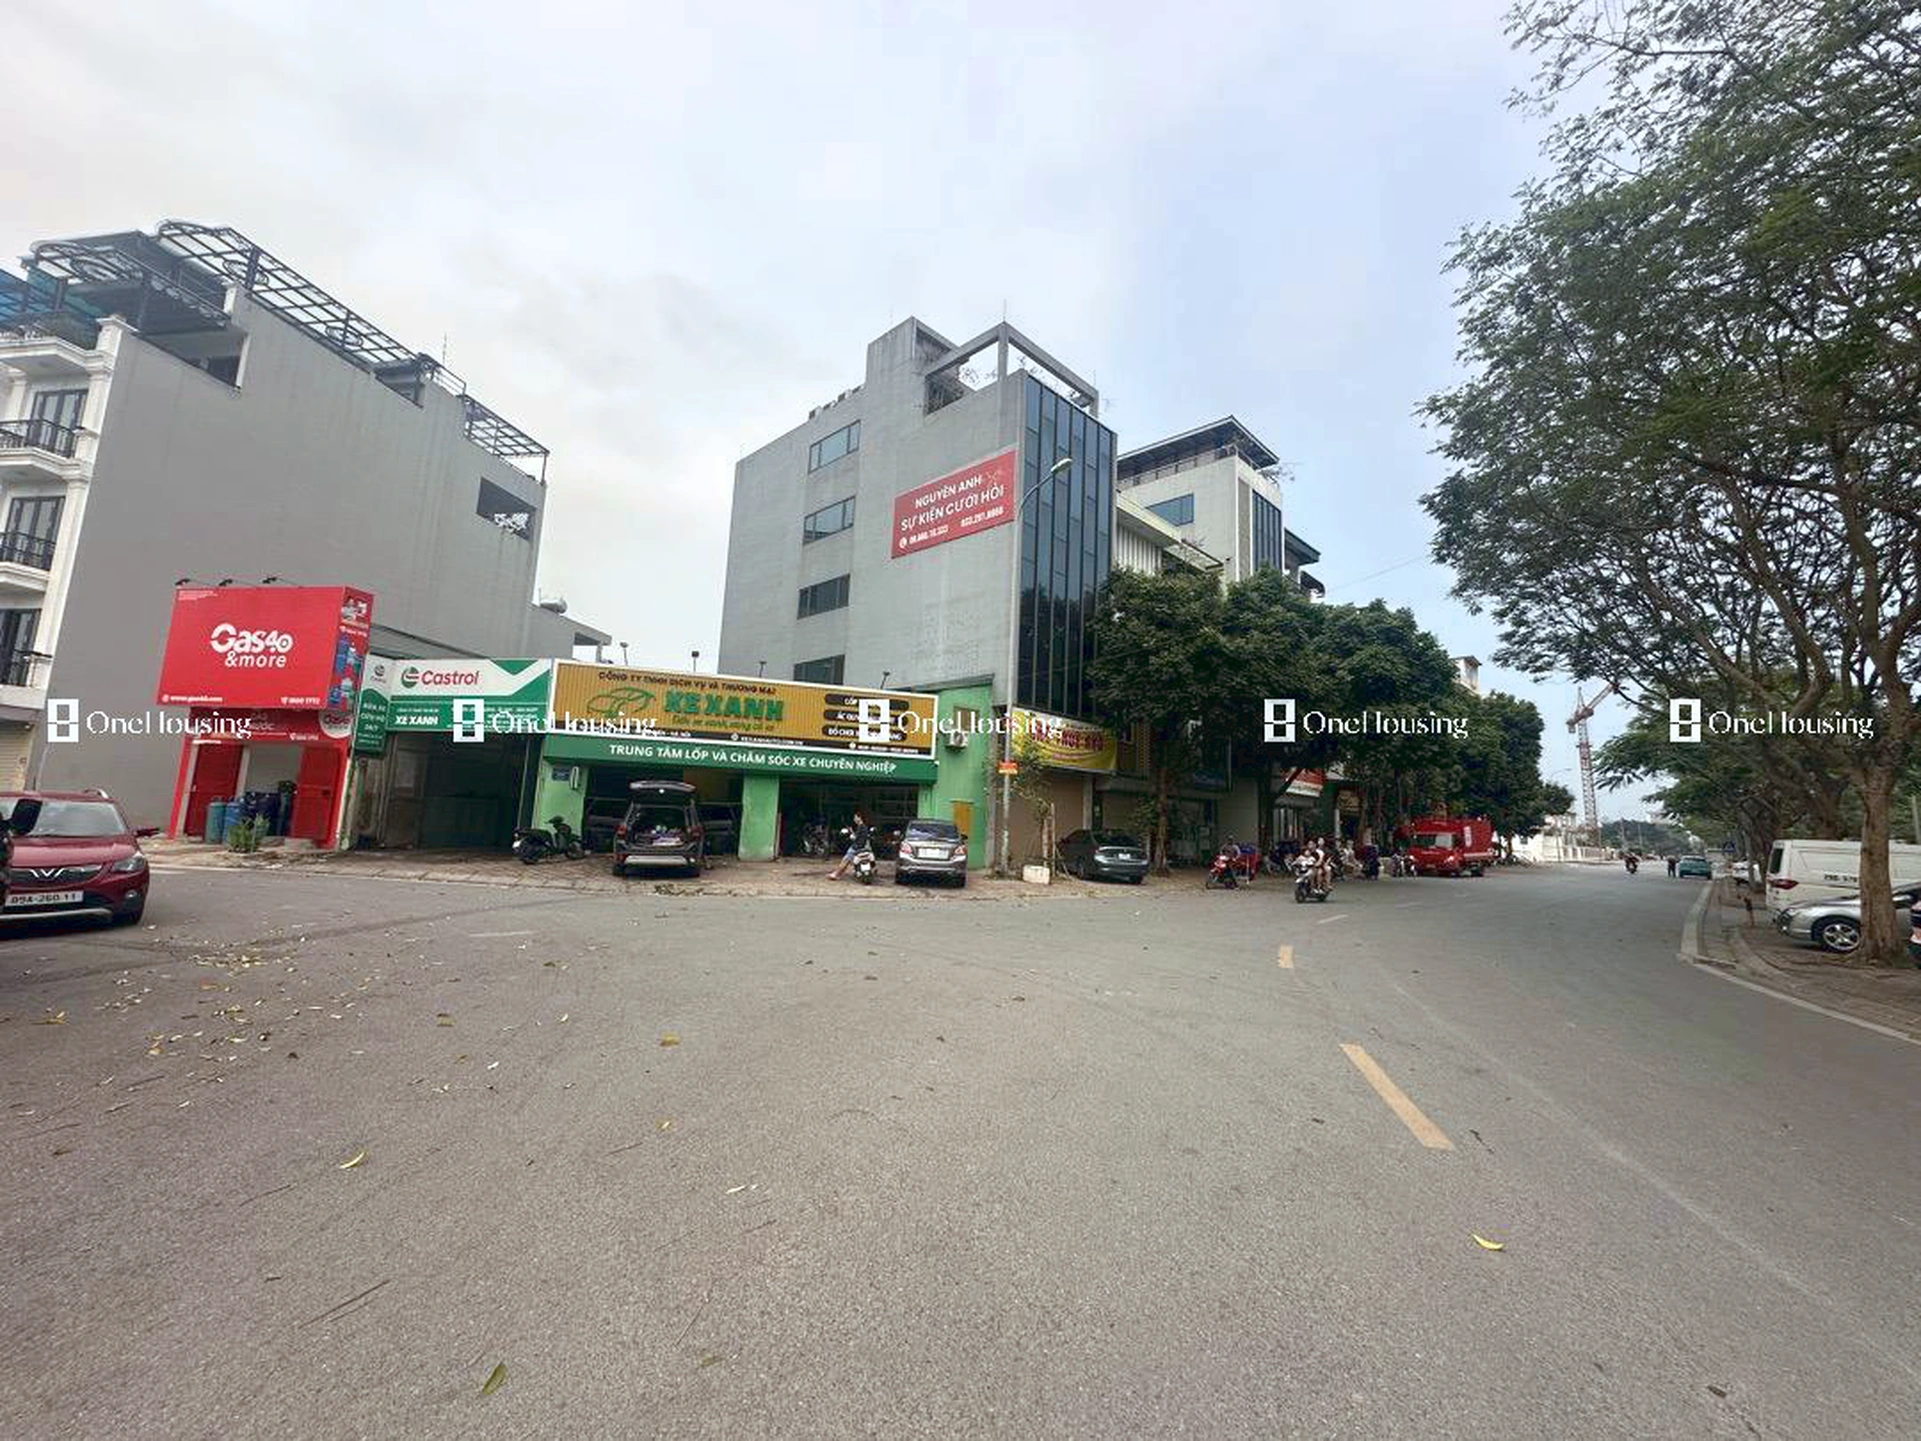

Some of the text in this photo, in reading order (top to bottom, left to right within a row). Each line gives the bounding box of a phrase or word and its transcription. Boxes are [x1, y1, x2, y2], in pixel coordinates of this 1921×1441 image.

[958, 474, 982, 493] ANH
[901, 516, 916, 531] SỰ
[918, 505, 944, 526] KIỆN
[945, 492, 979, 515] CƯỚI
[421, 669, 480, 686] Castrol
[598, 670, 627, 681] CÔNG
[709, 680, 719, 690] VÀ
[704, 692, 784, 721] XANH
[395, 715, 407, 725] XE
[409, 715, 439, 725] XANH
[609, 744, 898, 775] TRUNG TÂM LỐP VÀ CHĂM SÓC XE CHUYÊN NGHIỆP
